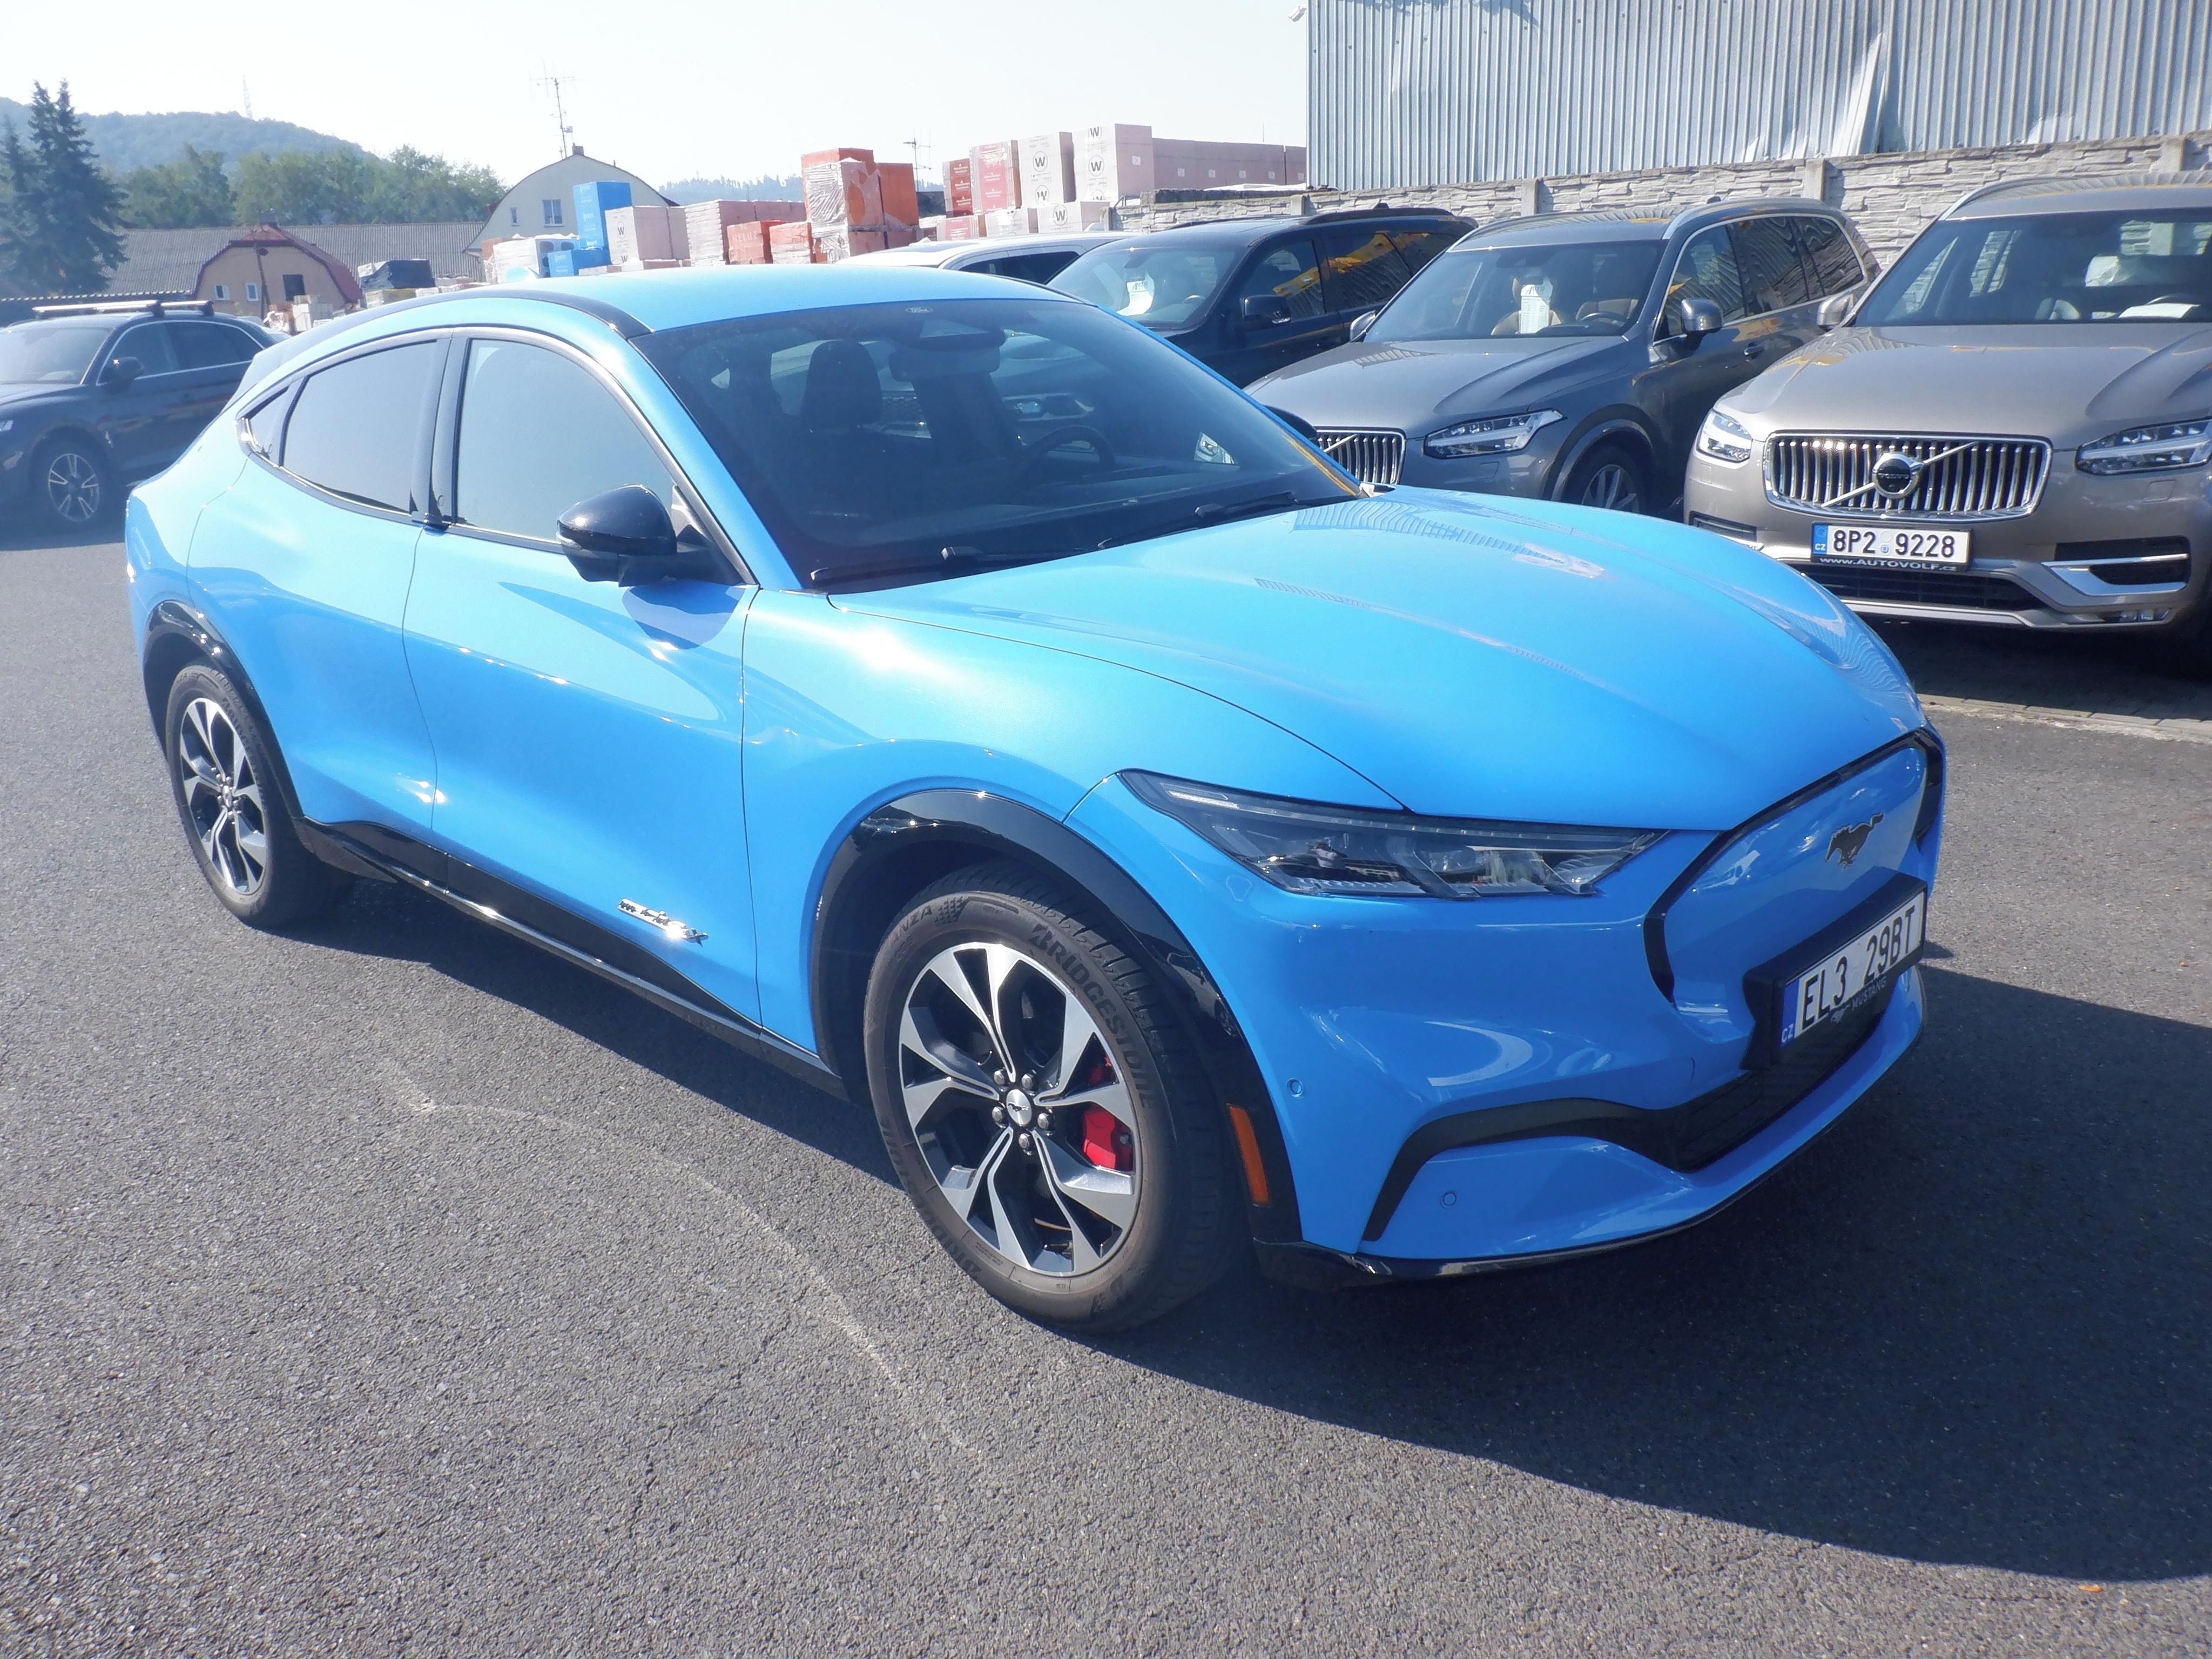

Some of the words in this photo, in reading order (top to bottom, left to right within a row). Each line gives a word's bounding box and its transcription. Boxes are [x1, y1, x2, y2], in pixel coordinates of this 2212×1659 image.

[1090, 126, 1100, 137] W
[1035, 156, 1046, 168] W
[1090, 160, 1102, 172] W
[1055, 210, 1066, 221] W
[617, 226, 625, 236] W
[1833, 530, 1876, 554] 8P2
[1894, 532, 1955, 558] 9228
[1819, 557, 1957, 571] www.AUTOVOLF.cz
[1802, 955, 1847, 1030] EL3
[1863, 905, 1915, 986] 29BT
[1782, 1023, 1795, 1043] CZ
